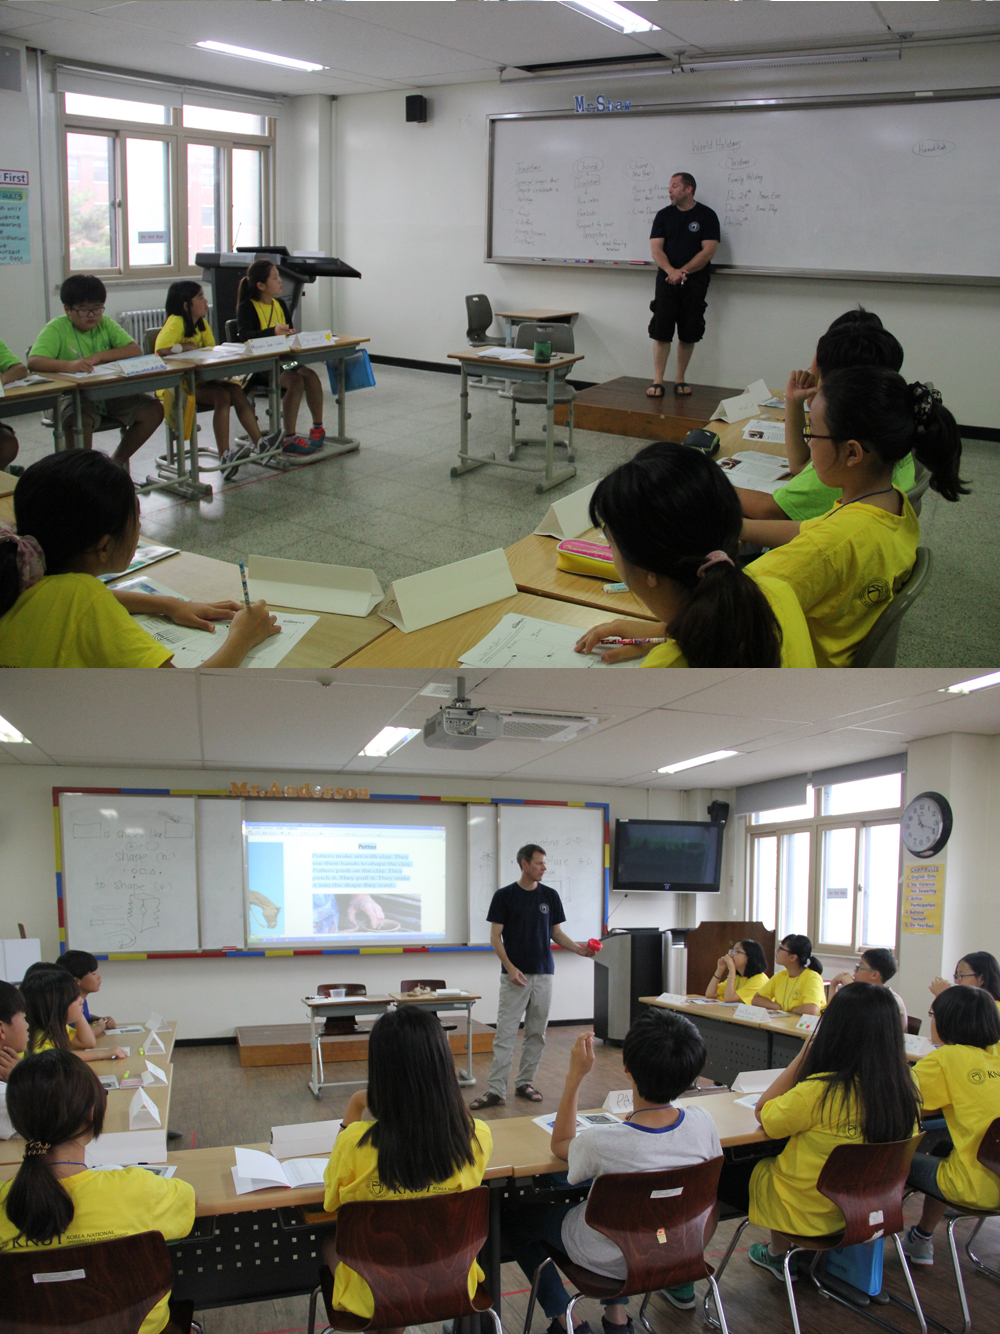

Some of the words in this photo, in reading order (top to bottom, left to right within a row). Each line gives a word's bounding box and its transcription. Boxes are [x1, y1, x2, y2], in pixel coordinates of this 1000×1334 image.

[692, 139, 713, 152] World
[4, 173, 25, 182] First
[115, 850, 148, 869] shape
[94, 877, 105, 890] to
[114, 879, 145, 895] shape
[617, 1093, 634, 1109] PA
[87, 1230, 114, 1238] NATIONAL
